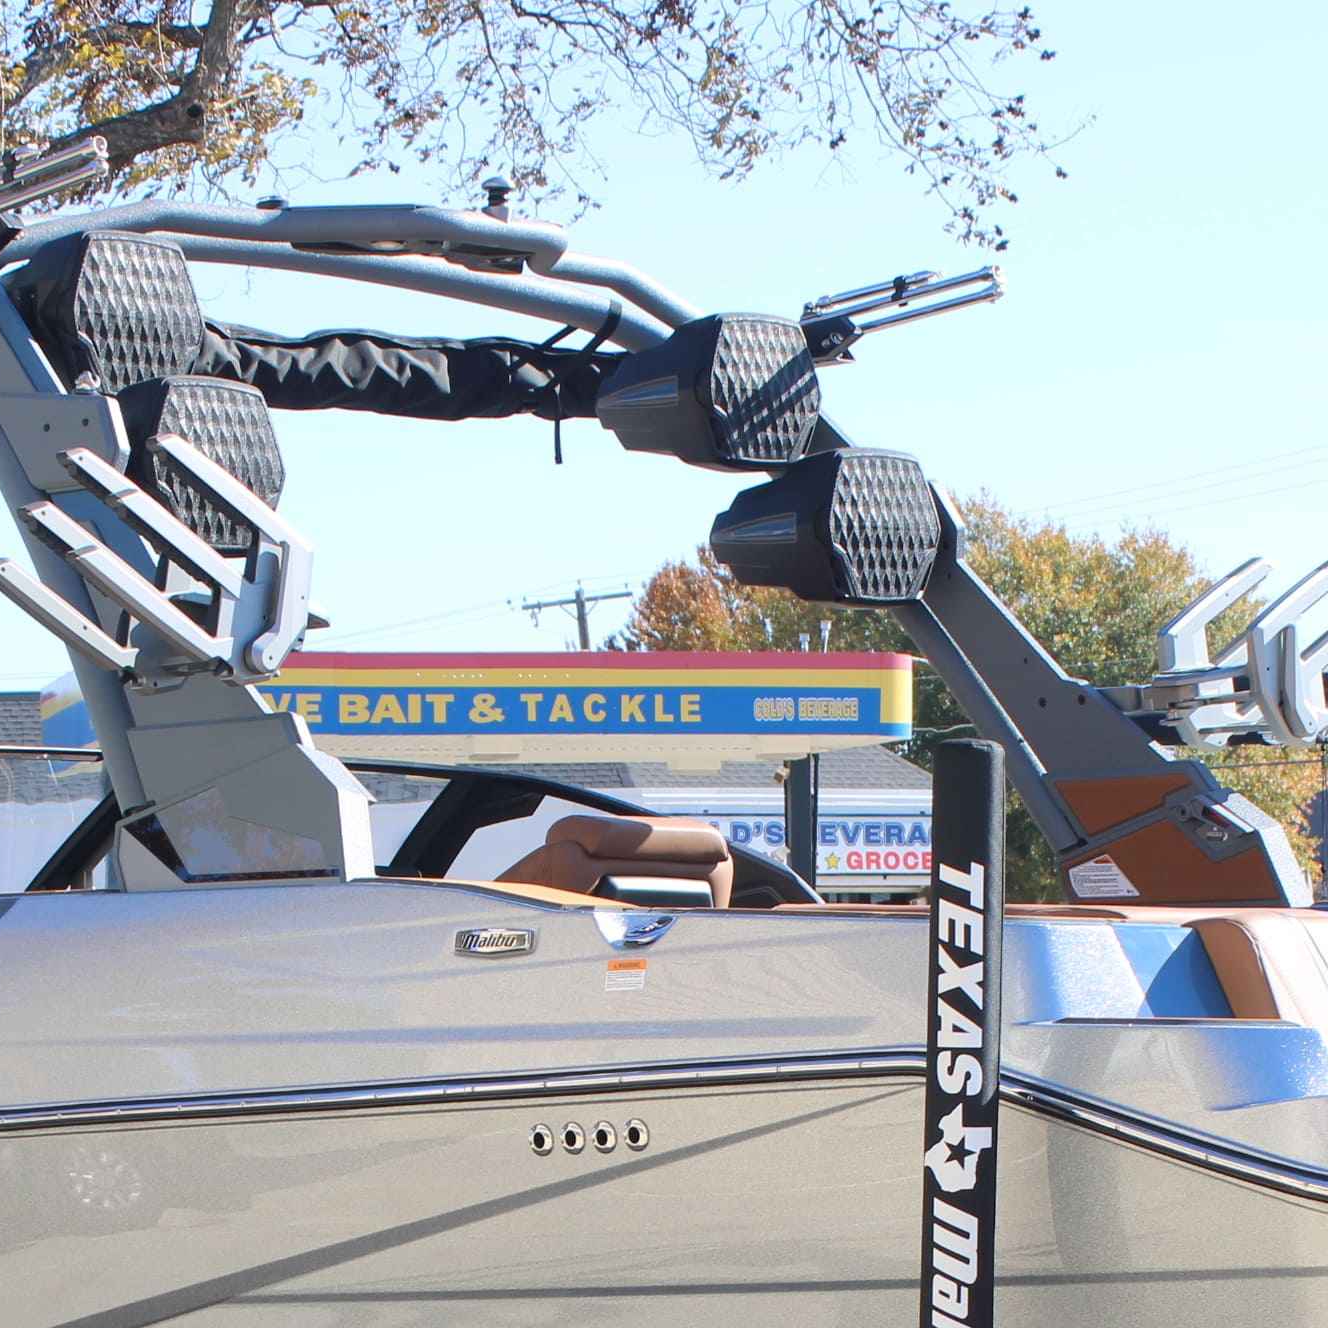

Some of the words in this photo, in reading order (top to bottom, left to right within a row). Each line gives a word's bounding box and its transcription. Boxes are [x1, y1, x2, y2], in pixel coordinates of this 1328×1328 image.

[338, 693, 455, 724] BAIT
[468, 693, 505, 723] &
[520, 693, 702, 723] TACKLE
[798, 697, 859, 721] BEVERAGE
[463, 932, 517, 948] Malibu
[937, 861, 985, 1097] TEXAS
